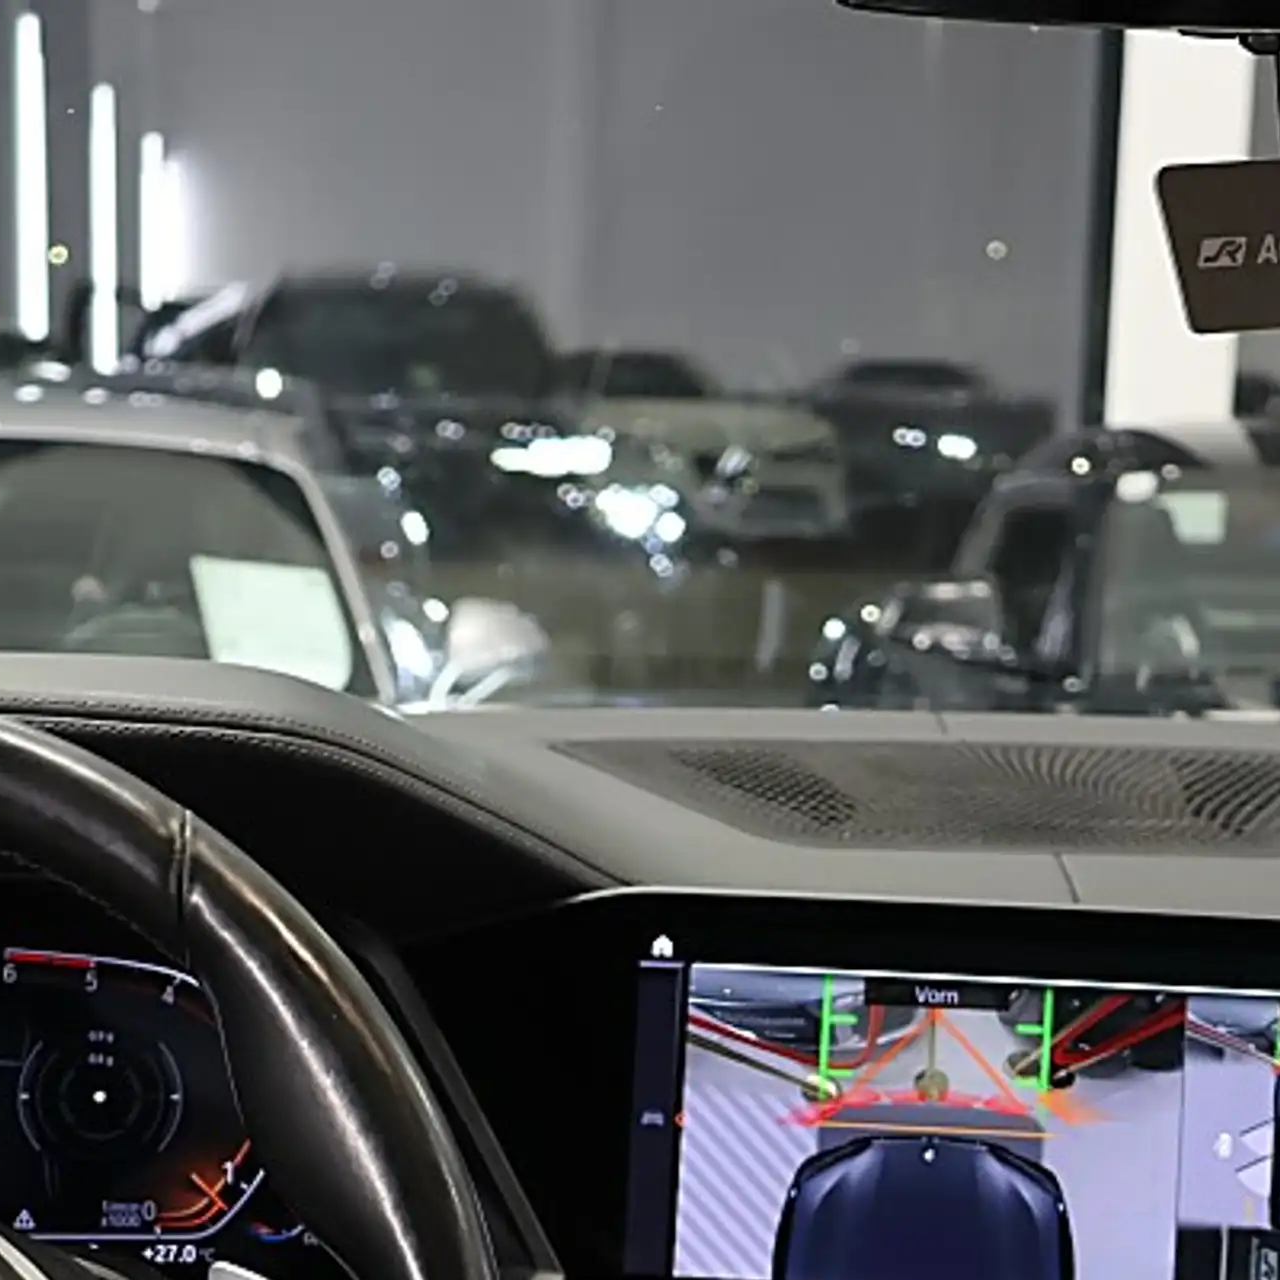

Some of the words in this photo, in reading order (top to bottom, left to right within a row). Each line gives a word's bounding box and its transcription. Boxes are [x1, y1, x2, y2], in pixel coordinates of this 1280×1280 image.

[3, 964, 18, 984] 6
[85, 971, 99, 992] 5
[161, 985, 176, 1006] 4
[914, 985, 959, 1006] Vorn
[225, 1161, 236, 1183] 1
[141, 1200, 157, 1221] 0
[141, 1244, 197, 1265] +27.0
